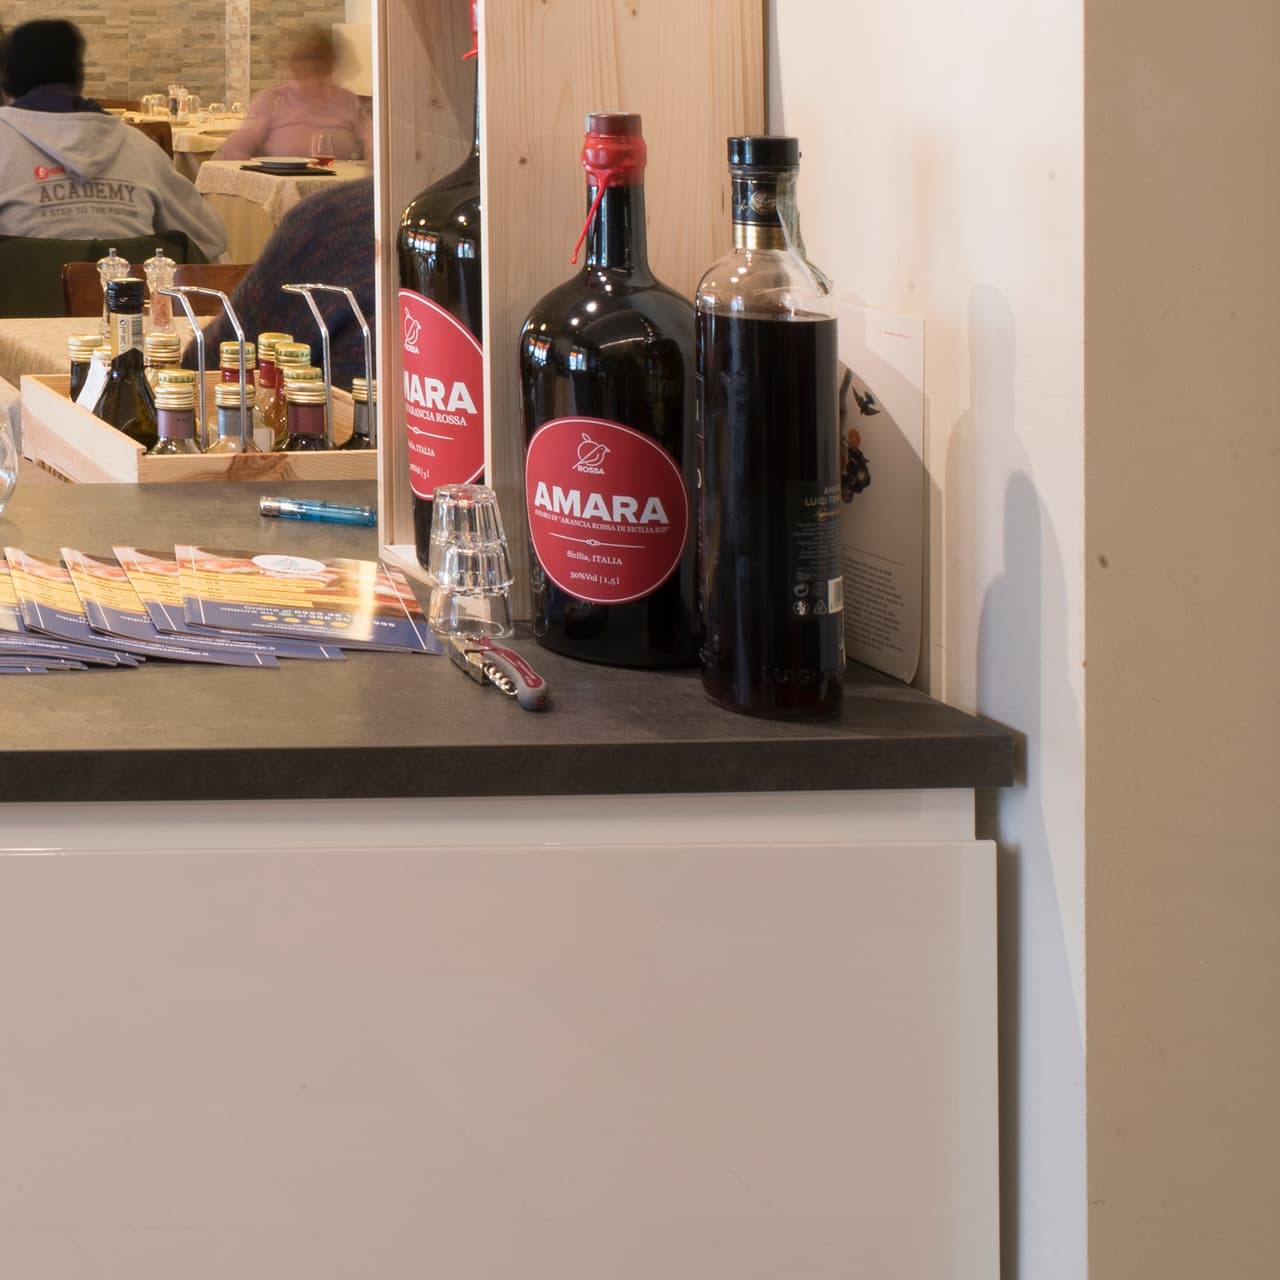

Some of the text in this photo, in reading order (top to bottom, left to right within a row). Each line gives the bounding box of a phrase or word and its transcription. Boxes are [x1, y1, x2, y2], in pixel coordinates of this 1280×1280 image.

[39, 181, 136, 203] ACADEMY
[577, 465, 606, 475] ROSSA
[534, 481, 670, 524] AMARA
[592, 522, 617, 532] ROSSA
[617, 525, 626, 533] DI
[626, 526, 655, 534] SICILIA
[566, 549, 623, 566] Sicilia, ITALIA
